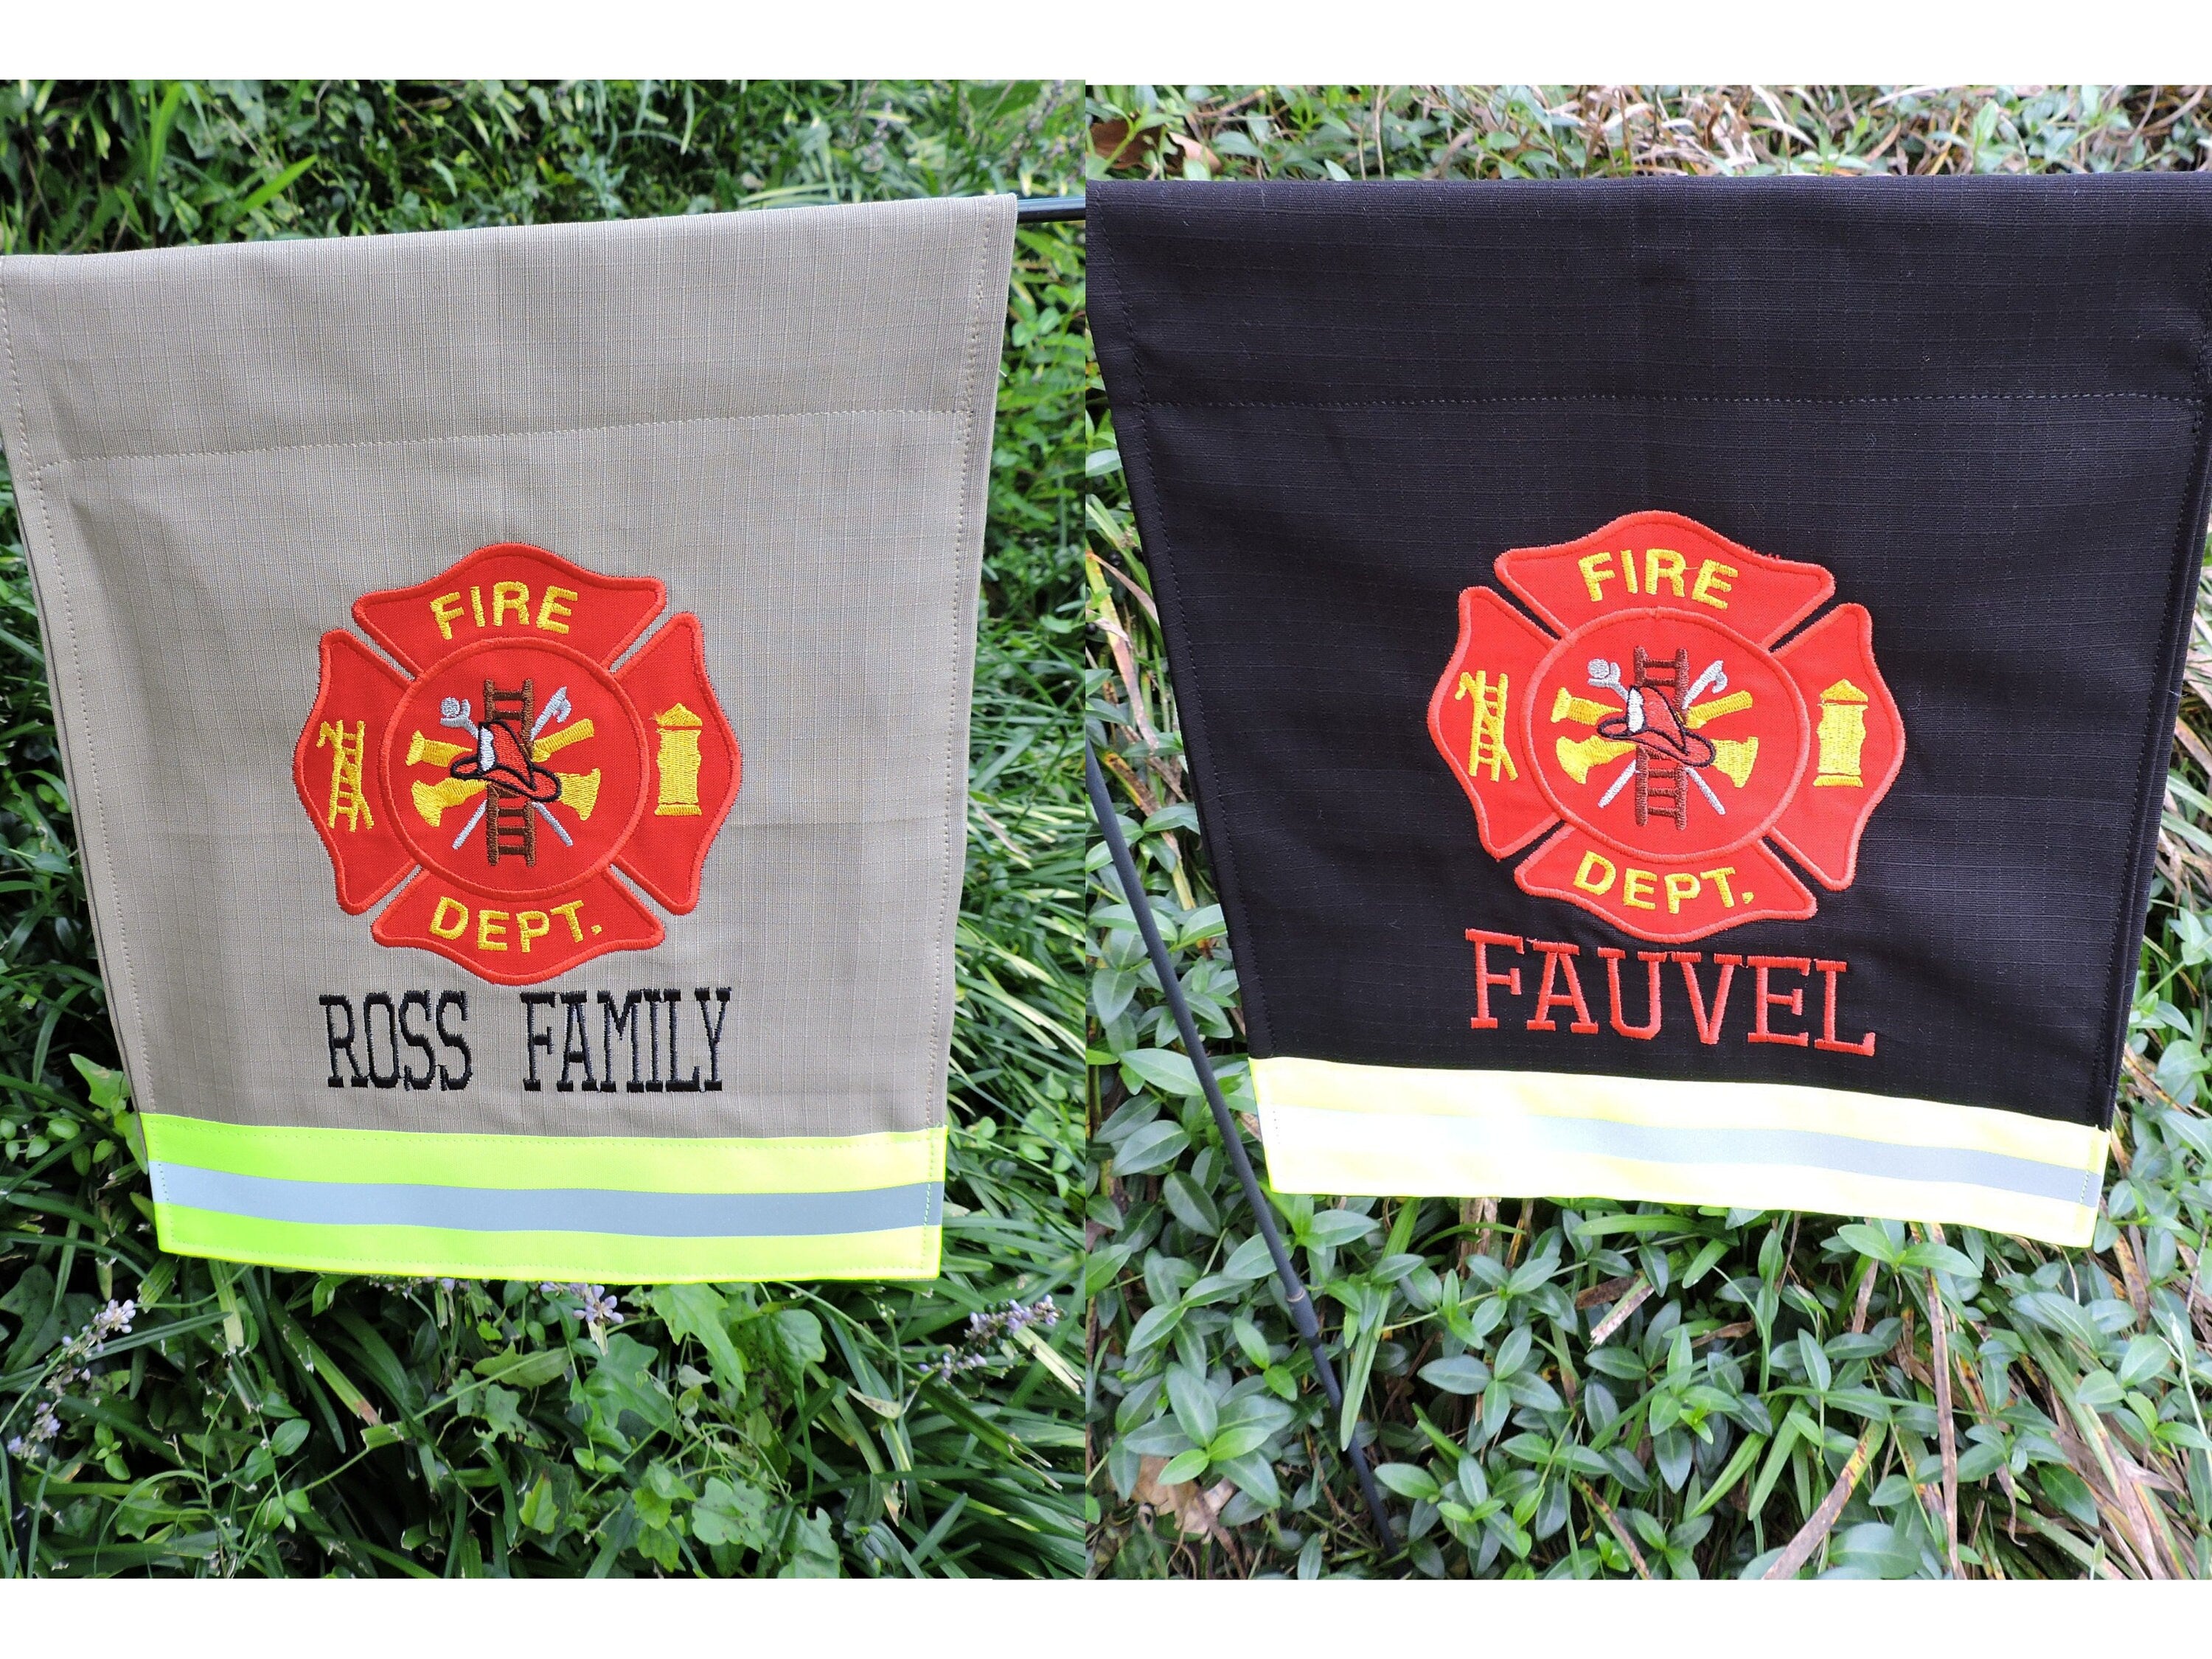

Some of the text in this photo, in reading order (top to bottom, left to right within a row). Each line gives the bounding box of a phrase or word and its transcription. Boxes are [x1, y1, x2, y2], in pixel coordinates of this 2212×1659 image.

[431, 581, 578, 639] FIRE
[1578, 549, 1739, 609] FIRE
[1573, 850, 1754, 914] DEPT.
[431, 897, 602, 953] DEPT.
[1465, 928, 1875, 1057] FAUVEL
[319, 987, 731, 1093] ROSS FAMILY
